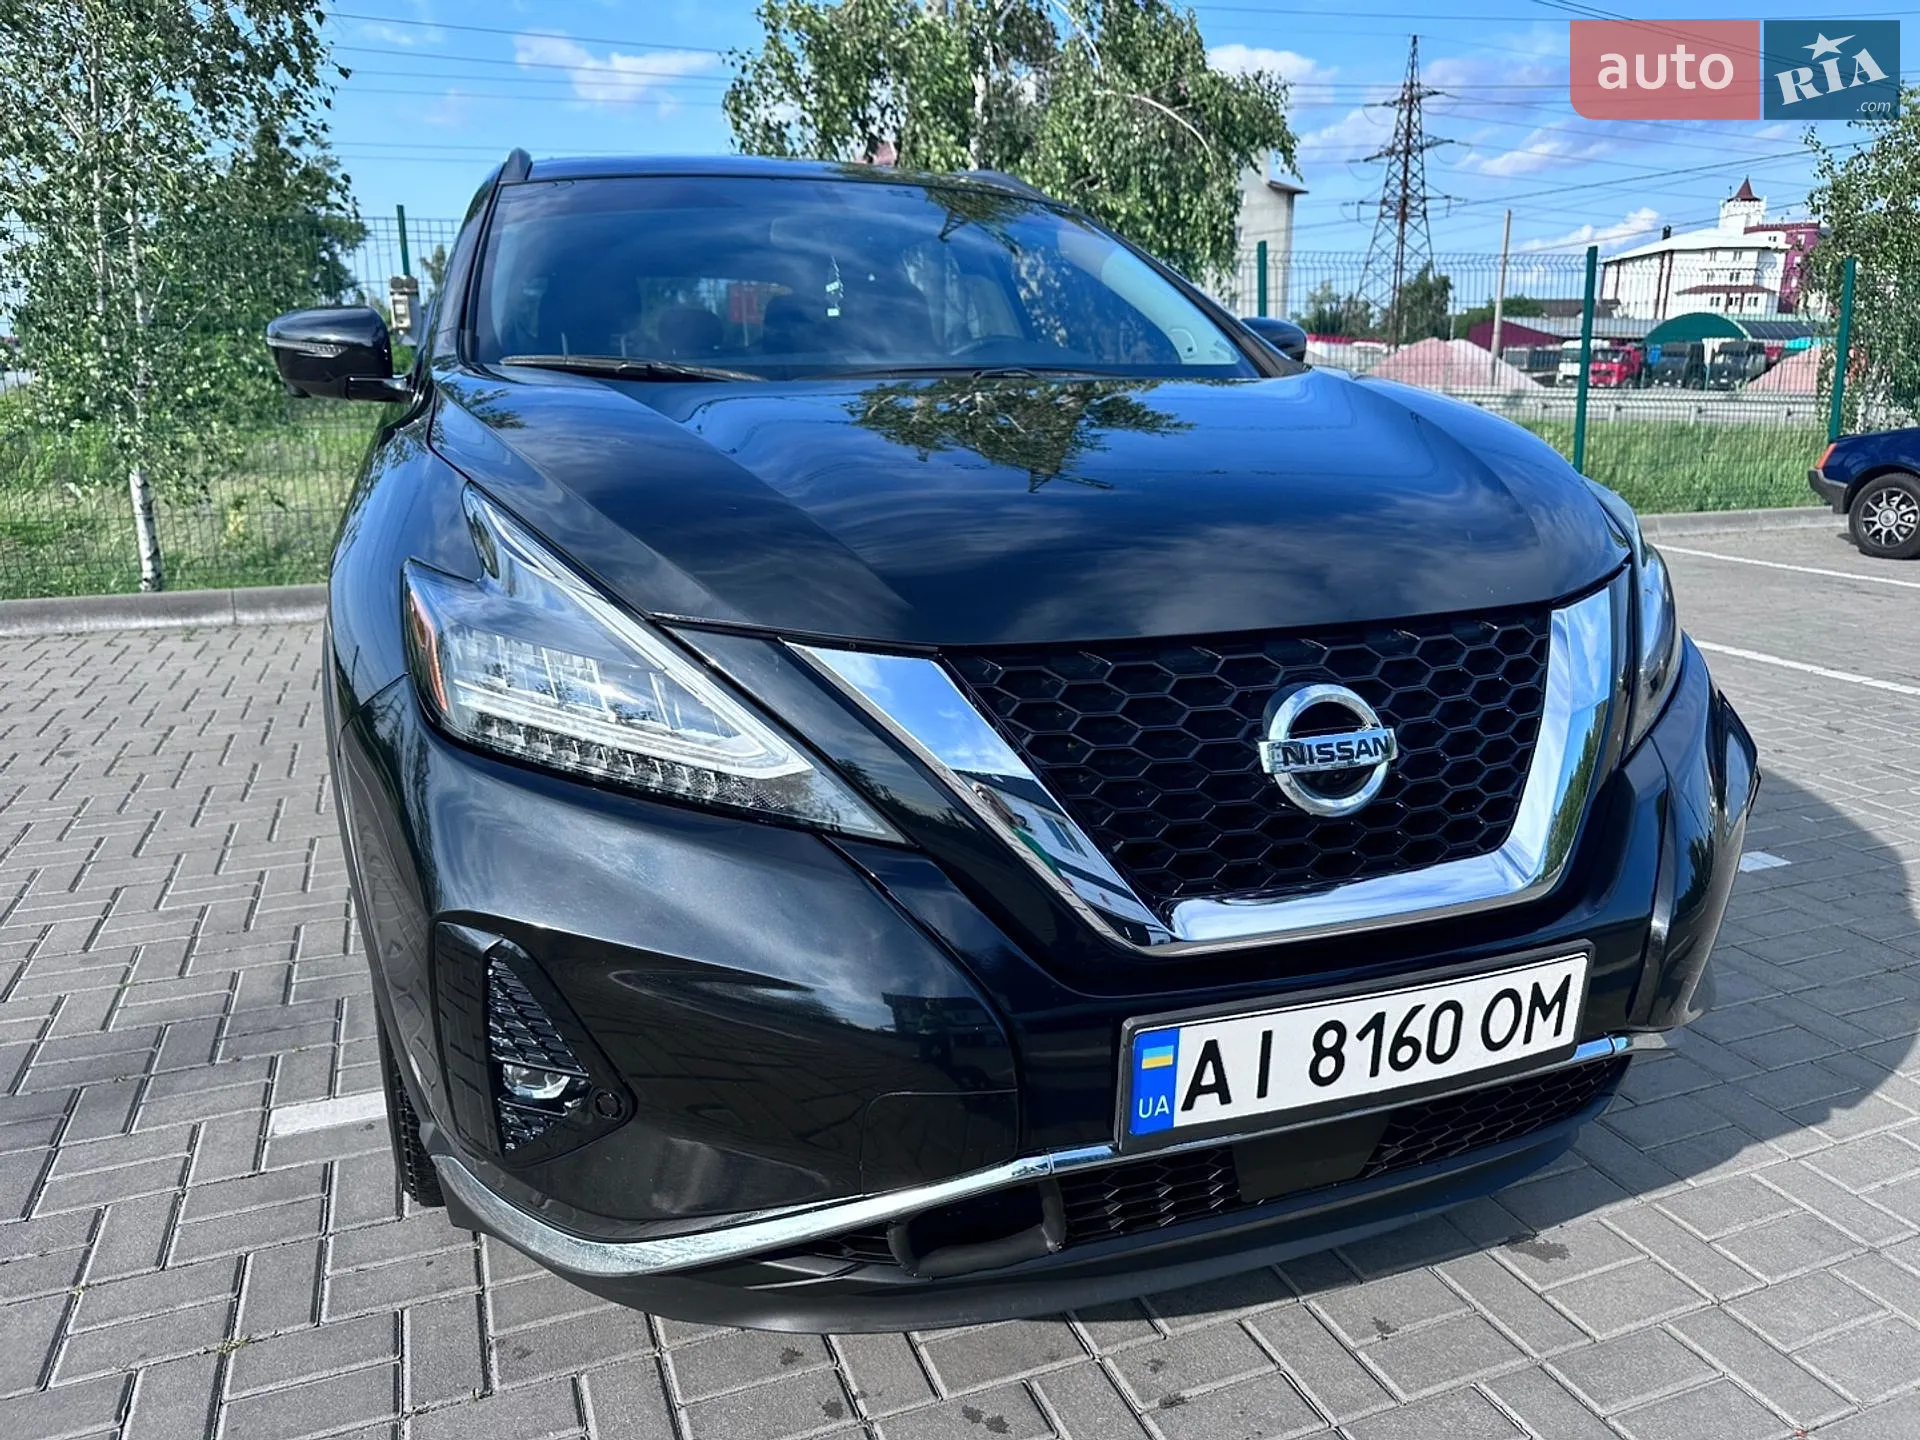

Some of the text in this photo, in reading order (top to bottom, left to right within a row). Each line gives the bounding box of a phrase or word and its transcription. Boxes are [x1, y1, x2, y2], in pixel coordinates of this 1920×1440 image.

[1281, 735, 1389, 767] NISSAN
[1180, 974, 1573, 1113] AI 8160 OM
[1138, 1094, 1171, 1120] UA
